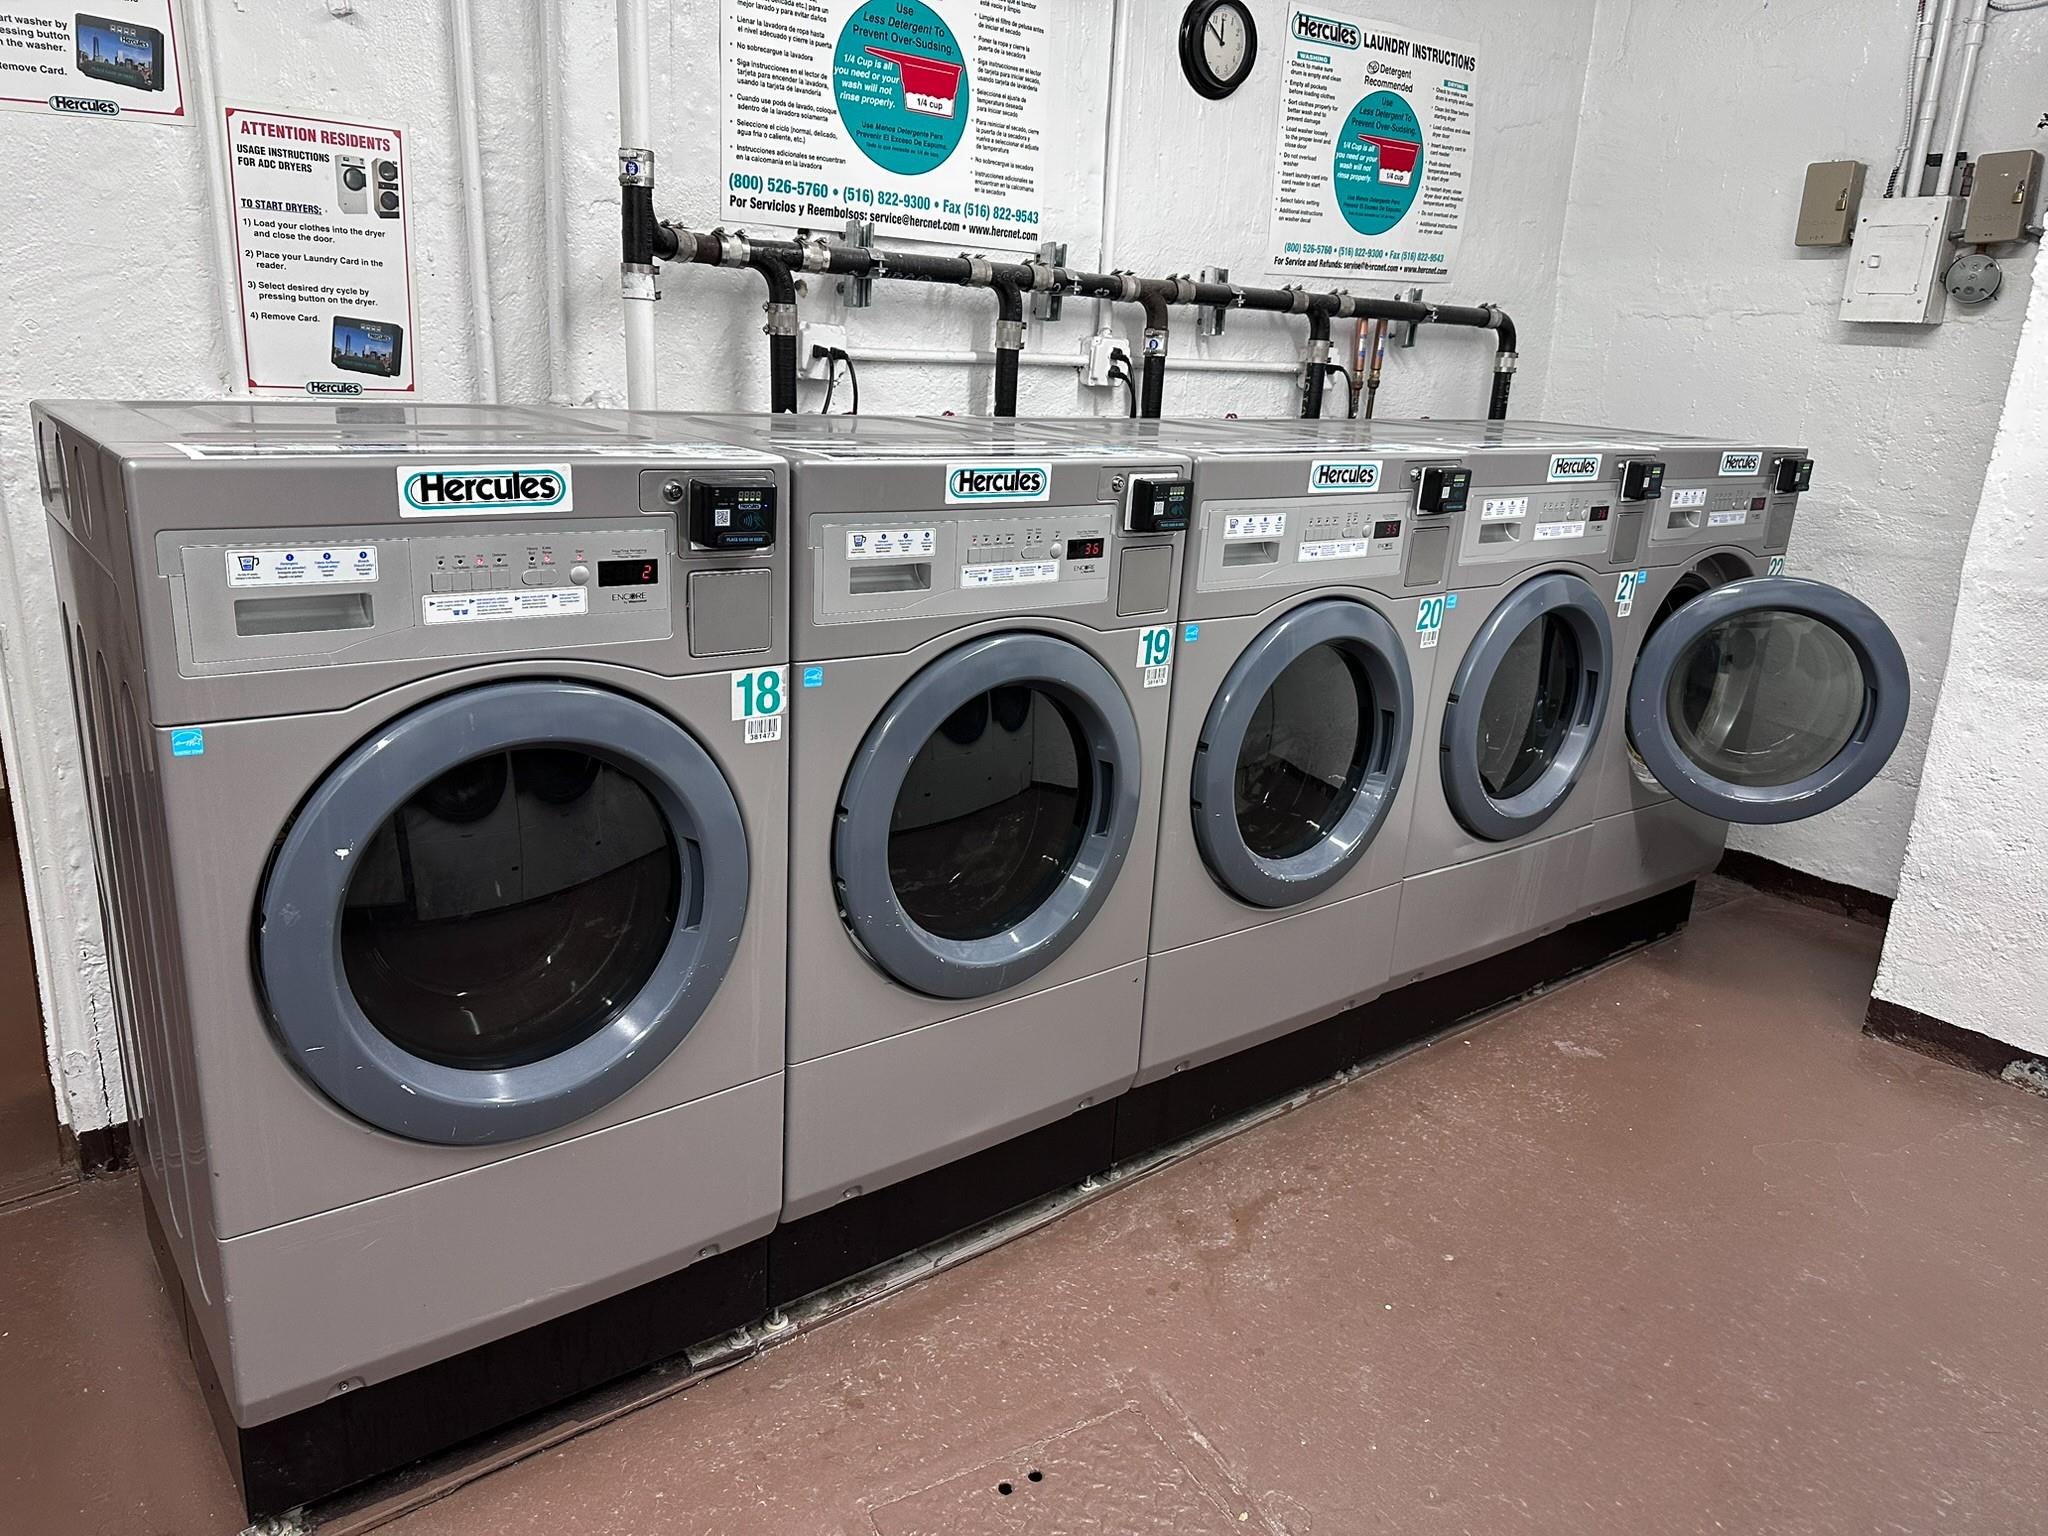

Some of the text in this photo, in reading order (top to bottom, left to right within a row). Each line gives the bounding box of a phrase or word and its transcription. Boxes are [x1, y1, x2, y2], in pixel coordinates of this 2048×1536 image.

[896, 2, 914, 16] Use
[14, 16, 52, 27] washer
[55, 20, 68, 30] by
[864, 11, 944, 37] Less Detergent To
[37, 30, 71, 41] button
[853, 24, 954, 56] Prevent Over-Sudsing.
[1298, 15, 1476, 72] Hercules LAUNDRY INSTRUCTIONS
[7, 39, 67, 52] the washer.
[737, 41, 745, 49] No
[747, 44, 782, 56] sobrecargue
[790, 51, 813, 61] lavadora
[40, 66, 68, 76] Card.
[737, 58, 750, 68] Siga
[751, 61, 789, 73] instrucciones
[804, 69, 819, 78] lector
[844, 54, 892, 71] 1/4 Cup is all
[834, 66, 849, 76] you
[851, 69, 869, 79] need
[882, 75, 900, 85] your
[1380, 64, 1412, 79] Detergent
[842, 78, 892, 95] wash will not
[1364, 76, 1413, 93] Recommended
[55, 96, 116, 114] Hercules
[840, 90, 896, 109] rinse properly.
[917, 98, 943, 111] 1/4 cup
[241, 121, 390, 151] ATTENTION RESIDENTS
[237, 144, 330, 162] USAGE INSTRUCTIONS
[238, 156, 312, 172] FOR ADC DRYERS
[1340, 162, 1352, 170] wash
[241, 198, 321, 214] TO START DRYERS:
[729, 173, 1039, 224] (800) 526-5760 (516) 822-9300 Fax (516) 822-9543
[729, 194, 1038, 241] Por Servicios y Reembolsos: service@hercnet.com www.hercnet.com
[243, 218, 251, 227] 1)
[254, 218, 275, 227] Load
[299, 223, 330, 232] clothes
[332, 225, 348, 234] into
[365, 229, 385, 238] dryer
[272, 231, 295, 239] close
[297, 233, 311, 241] the
[313, 234, 335, 243] door.
[245, 249, 254, 258] 2)
[256, 250, 280, 259] Place
[303, 254, 338, 265] Laundry
[340, 256, 359, 265] Card
[1284, 241, 1444, 263] (800) 526-5760 (516) 822-9300 Fax (516) 822-9543
[1274, 257, 1283, 265] For
[1285, 258, 1305, 267] Service
[1307, 259, 1317, 268] and
[1319, 260, 1342, 269] Refunds:
[1404, 266, 1447, 275] www.hercnet.com
[248, 280, 256, 290] 3)
[258, 281, 285, 290] Select
[287, 283, 318, 292] desired
[320, 286, 334, 295] dry
[359, 288, 369, 297] by
[259, 293, 296, 302] pressing
[298, 294, 325, 302] button
[355, 298, 378, 306] dryer.
[250, 311, 320, 322] 4) Remove Card.
[311, 382, 359, 394] Hercules
[1554, 458, 1595, 475] Hercules
[1724, 455, 1756, 470] Hercules
[958, 469, 1040, 492] Hercules
[1318, 465, 1374, 484] Hercules
[420, 472, 556, 502] Hercules
[1085, 543, 1099, 554] 36
[642, 564, 652, 580] 2
[1770, 558, 1783, 576] 22
[1617, 573, 1637, 600] 21
[1416, 598, 1442, 630] 20
[1142, 629, 1170, 665] 19
[736, 670, 780, 716] 18
